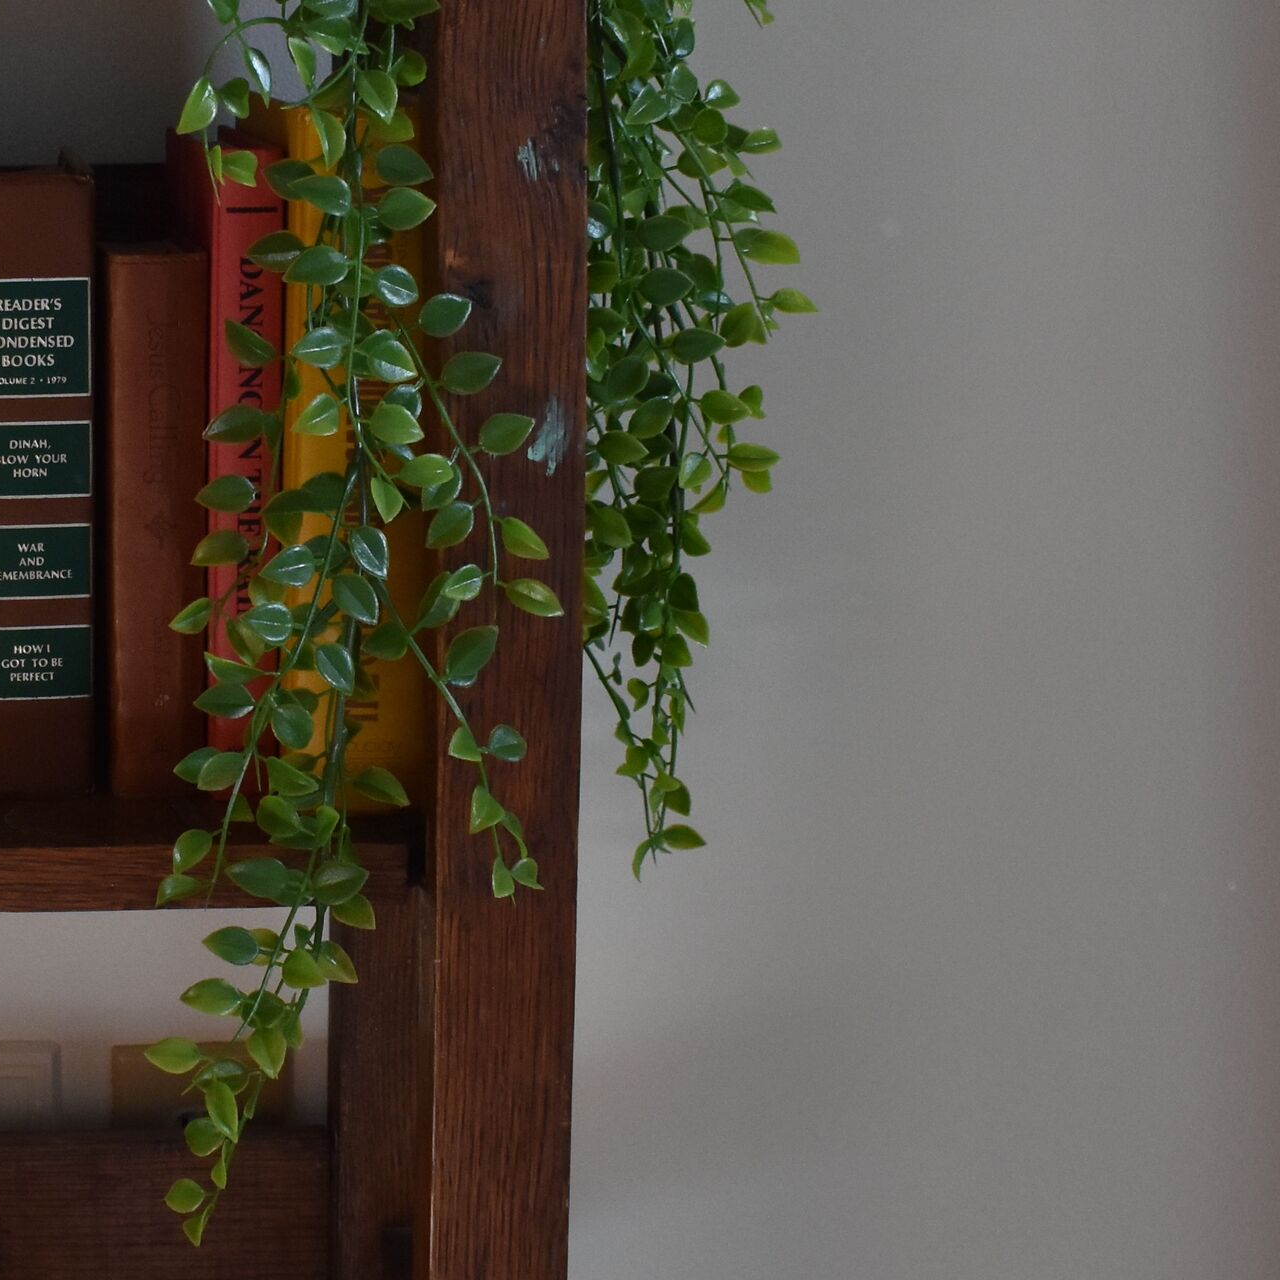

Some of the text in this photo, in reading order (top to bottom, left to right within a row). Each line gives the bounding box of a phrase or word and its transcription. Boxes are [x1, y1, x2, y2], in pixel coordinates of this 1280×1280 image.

[1, 317, 55, 330] DIGEST
[1, 354, 55, 368] BOOKS
[30, 377, 35, 385] 2
[46, 376, 68, 385] 1979
[9, 439, 51, 451] DINAH,
[34, 453, 68, 464] YOUR
[13, 468, 48, 478] HORN
[17, 542, 45, 553] WAR
[19, 556, 45, 567] AND
[13, 644, 42, 654] HOW
[1, 657, 64, 669] GOT TO BE
[9, 672, 55, 682] PERFECT
